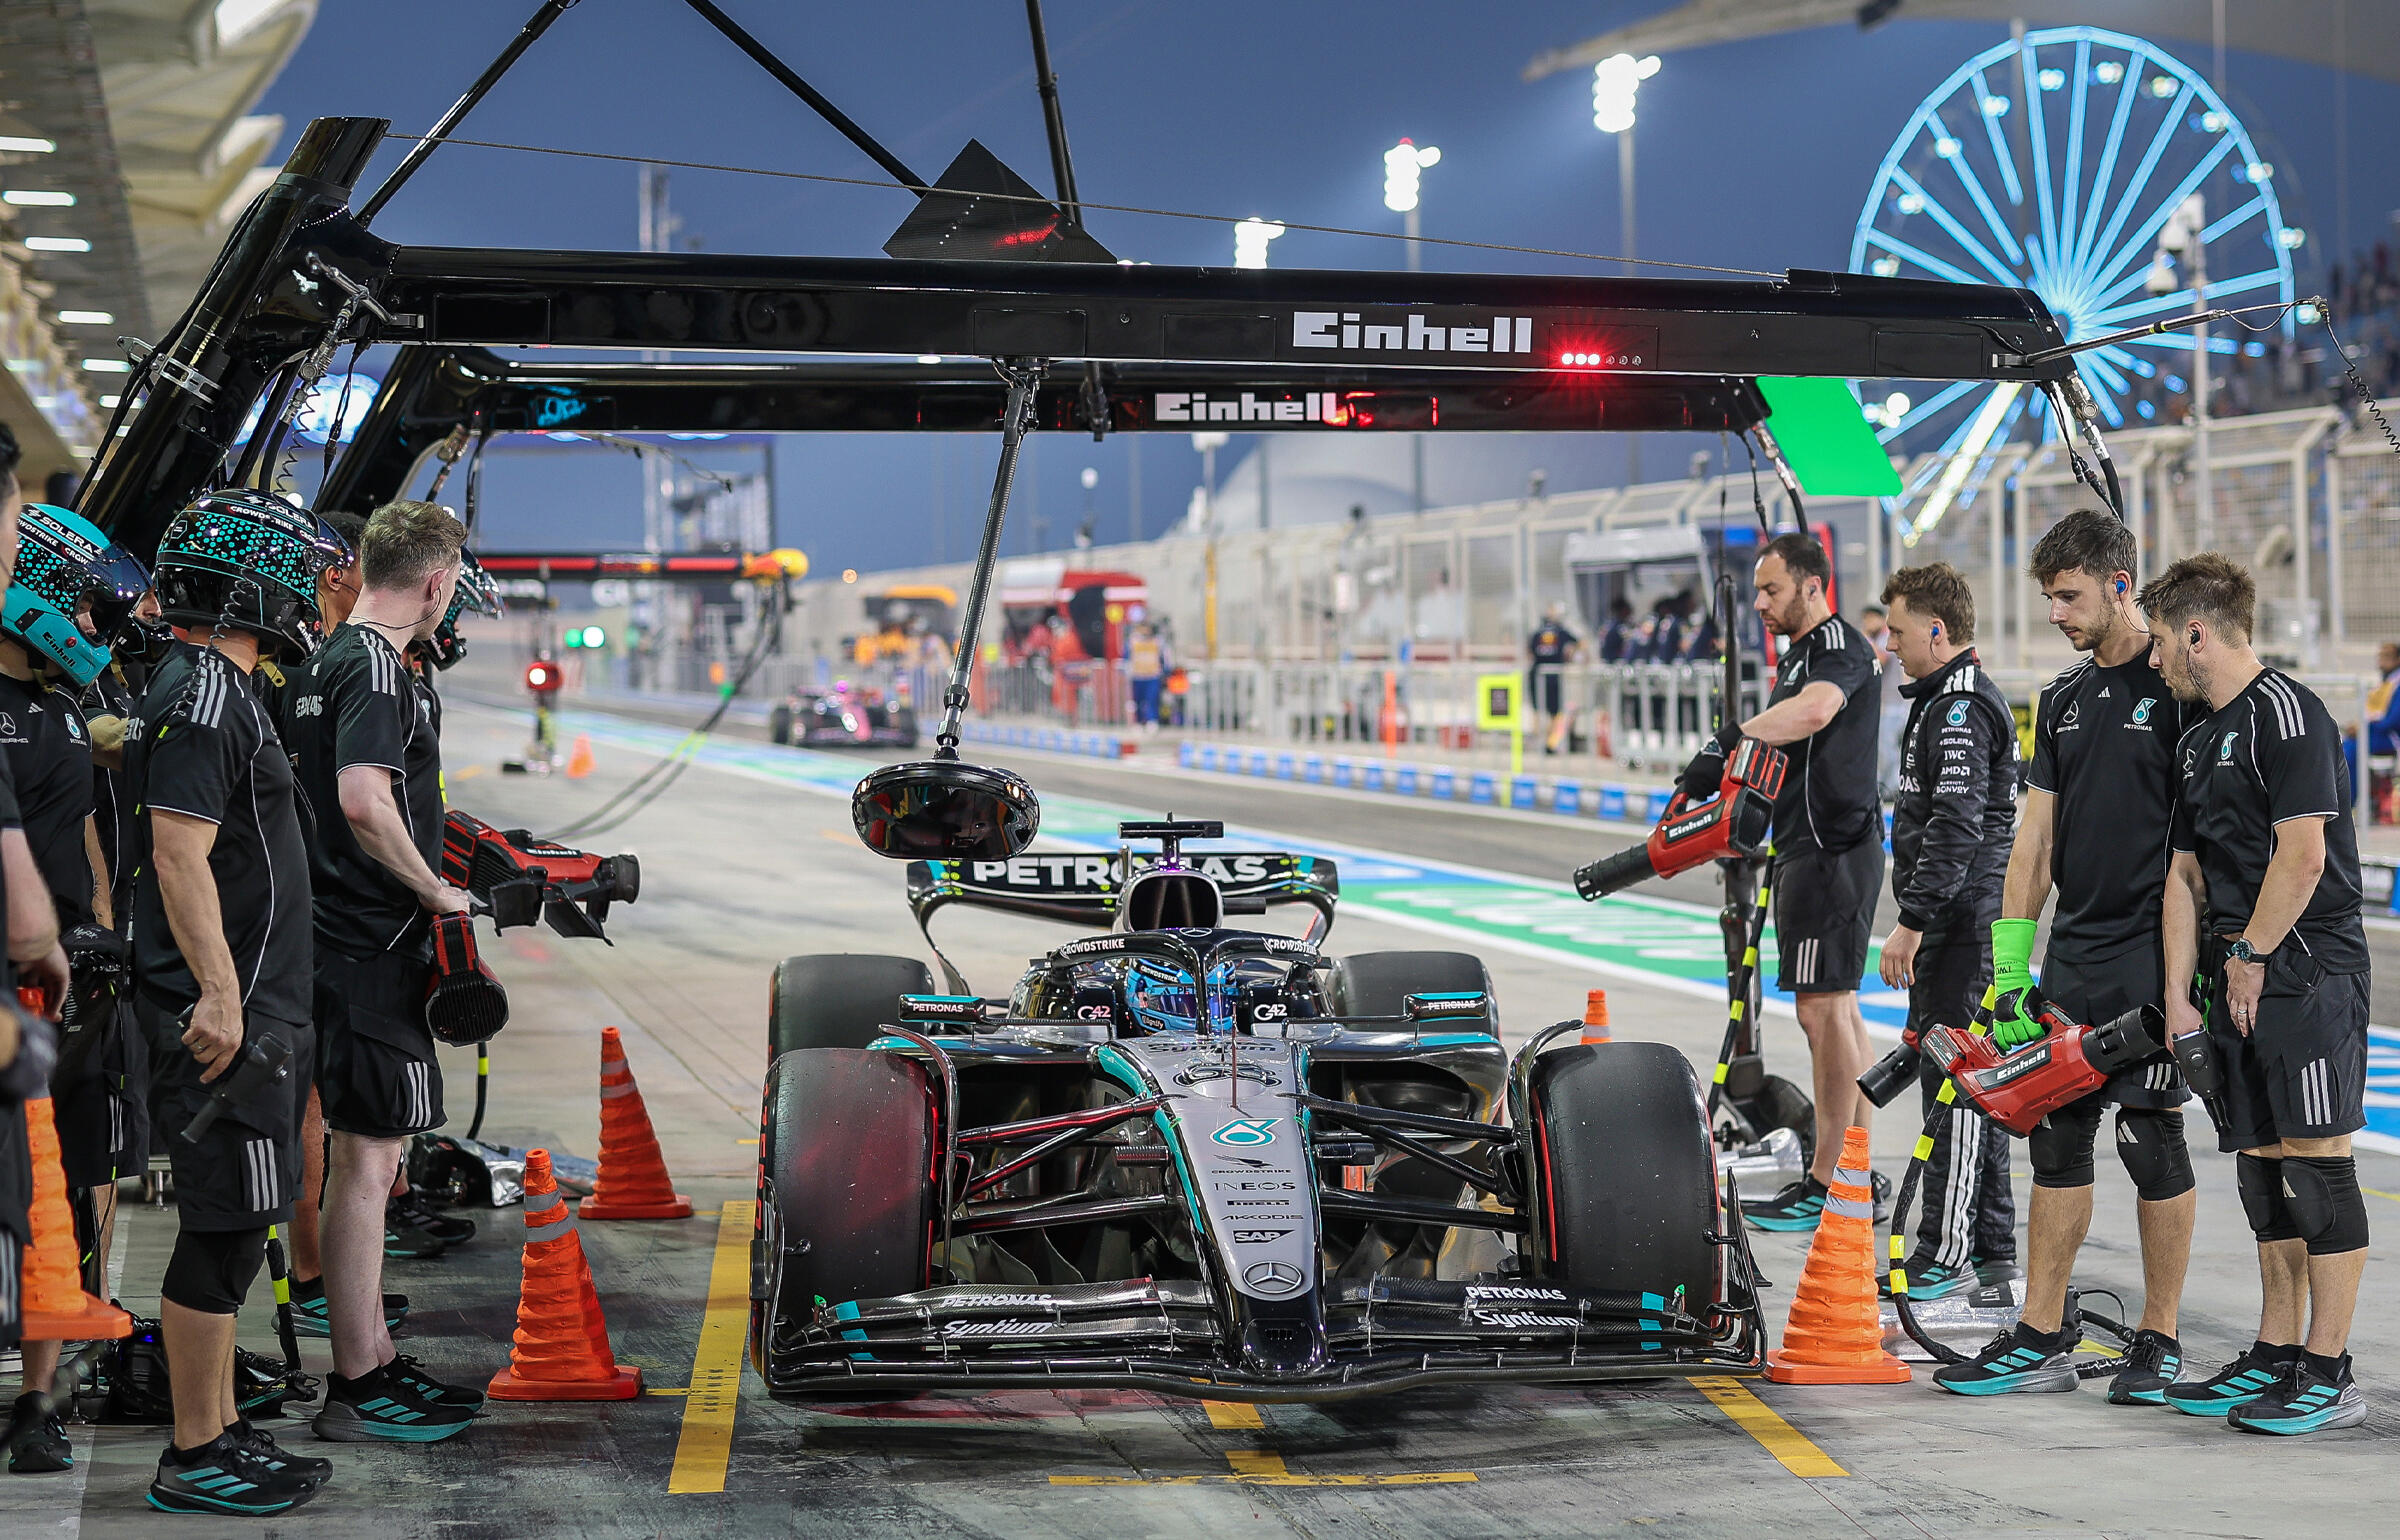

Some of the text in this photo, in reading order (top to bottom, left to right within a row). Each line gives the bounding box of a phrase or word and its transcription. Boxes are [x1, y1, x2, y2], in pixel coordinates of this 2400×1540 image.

[1293, 312, 1532, 353] Einhell
[1155, 392, 1337, 421] Einhell
[16, 518, 59, 547] OWDSTRIKE
[39, 516, 93, 554] SOLERA
[42, 631, 76, 668] Einhell
[2123, 723, 2153, 732] PETRONAS
[1943, 738, 1974, 747] SOLERA
[1944, 750, 1966, 760] IWC
[1940, 766, 1960, 776] AMD
[1936, 785, 1970, 794] BONVOY
[1669, 813, 1713, 838] Einhell
[973, 855, 1268, 887] PETROAS
[1061, 939, 1125, 956] CROWDSTRIKE
[1267, 938, 1317, 956] CROWDSTRIKE
[1140, 965, 1179, 983] CROWDSTRIKE
[912, 1003, 964, 1013] PETRONAS
[1077, 1005, 1112, 1020] G42
[1254, 1004, 1288, 1021] G42
[1428, 1000, 1476, 1011] PETRONAS
[1996, 1049, 2046, 1081] Einhell
[1214, 1182, 1296, 1191] INEOS
[1234, 1231, 1281, 1242] SAP
[939, 1293, 1052, 1308] PETRONAS
[1465, 1286, 1567, 1300] PETRONAS
[1473, 1309, 1580, 1328] Syntium
[940, 1318, 1053, 1338] Syntium
